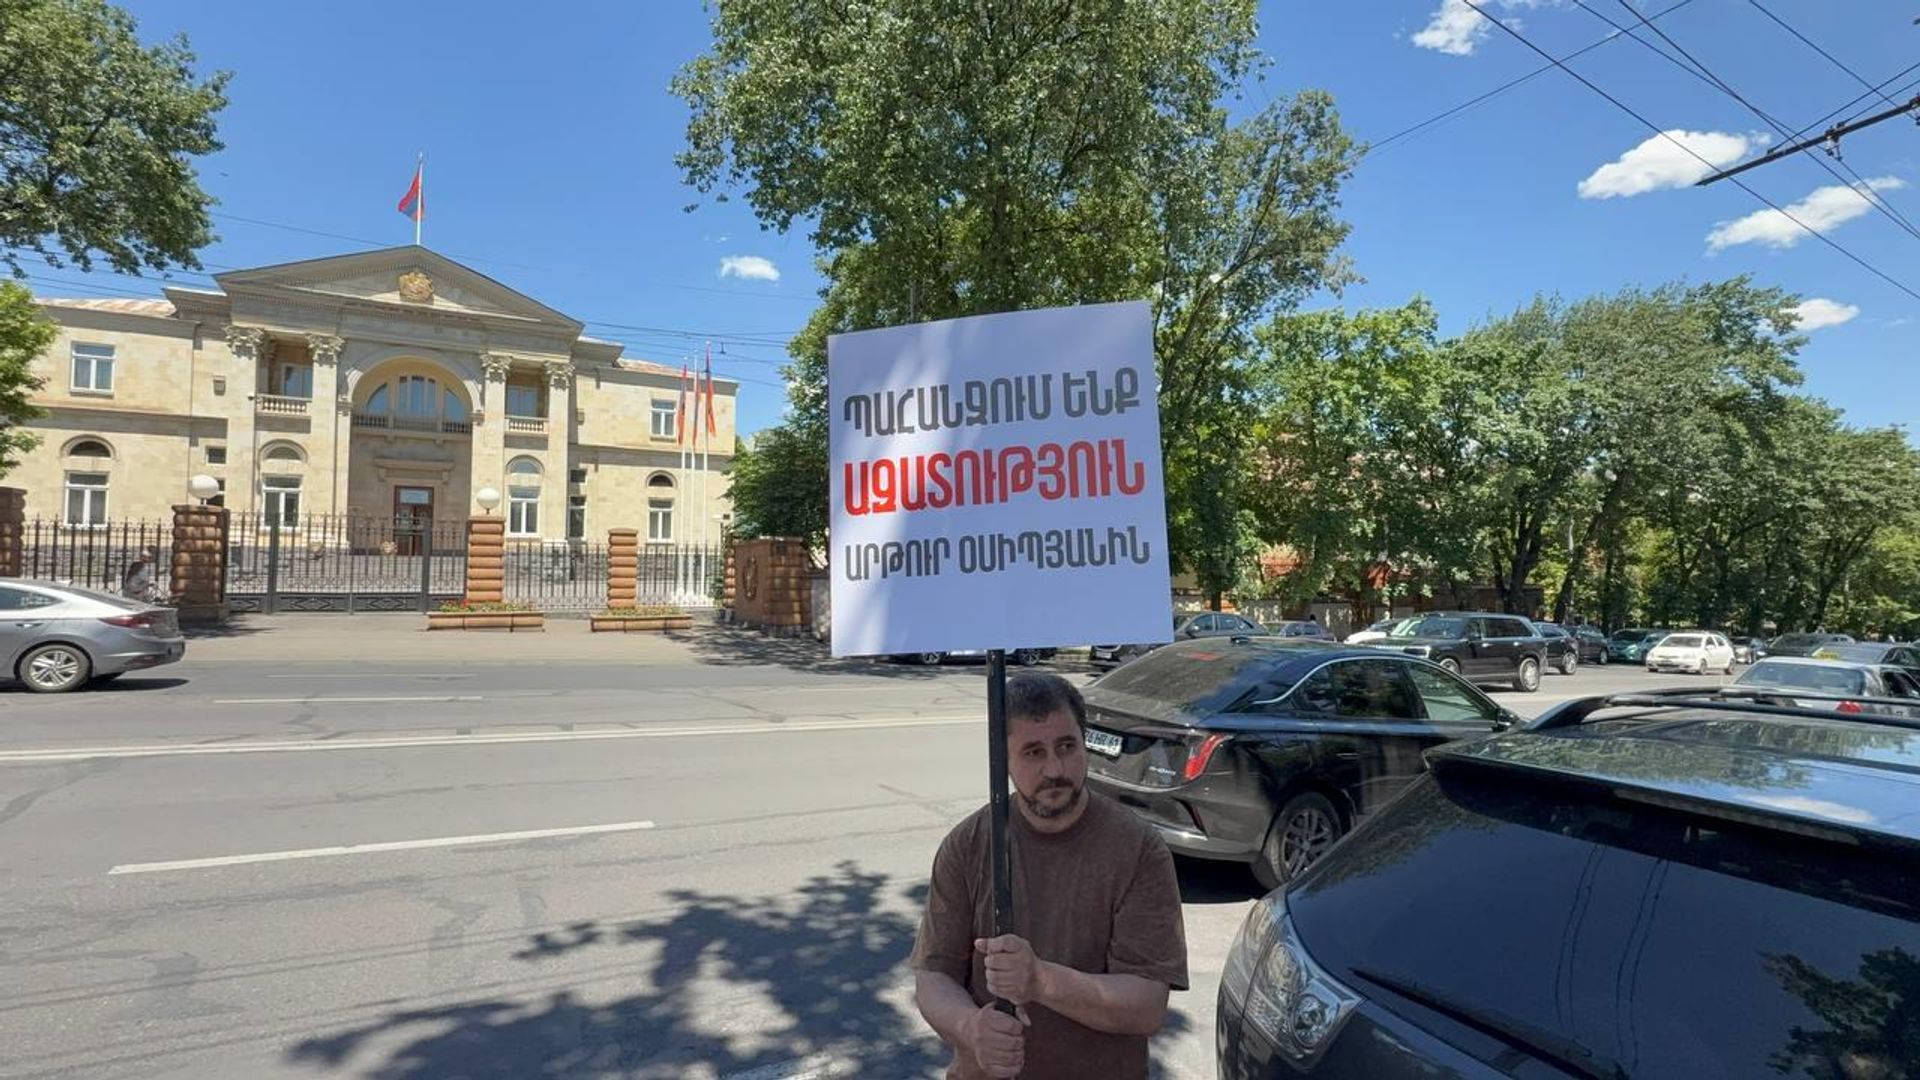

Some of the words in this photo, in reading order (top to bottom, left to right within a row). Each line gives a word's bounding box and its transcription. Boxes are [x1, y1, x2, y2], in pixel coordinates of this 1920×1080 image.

[844, 373, 1052, 437] ՊԱՀԱՆՋՈՒՄ
[1062, 366, 1140, 418] ԵՆՔ
[844, 439, 1145, 516] ԱԶԱՏՈՒԹՅՈՒՆ
[845, 537, 950, 582] ԱՐԹՈՒՐ
[958, 525, 1150, 575] ՕՍԻՊՅԱՆԻՆ
